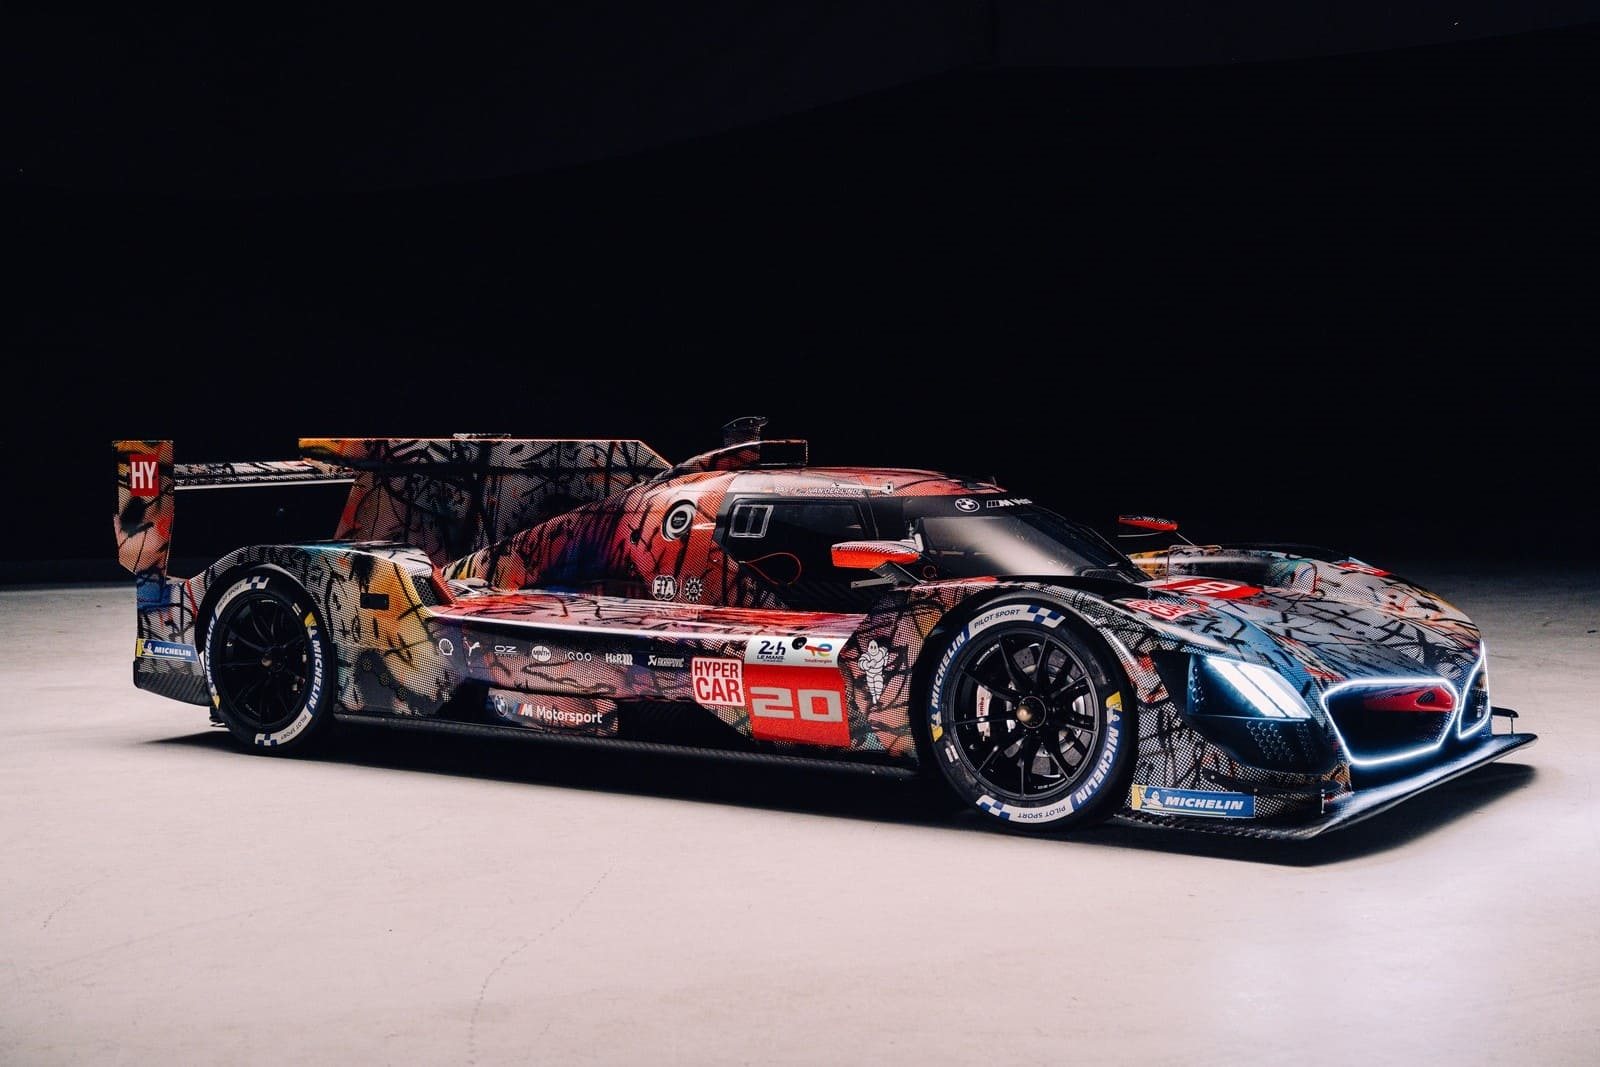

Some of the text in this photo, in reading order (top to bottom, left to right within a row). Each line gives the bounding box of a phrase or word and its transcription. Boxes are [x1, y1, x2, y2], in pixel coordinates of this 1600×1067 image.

[131, 461, 157, 489] HY
[974, 609, 1020, 629] PILOT SPORT
[154, 646, 192, 657] MICHELIN
[494, 645, 517, 653] OZ
[564, 651, 592, 662] iQOO
[309, 640, 323, 709] MICHELIN
[694, 660, 739, 678] HYPER
[931, 631, 966, 709] MICHELIN
[695, 677, 742, 703] CAR
[750, 686, 843, 723] 20
[537, 705, 603, 725] Motorsport
[280, 727, 296, 740] SPORT
[1075, 726, 1119, 805] MICHELIN
[1045, 805, 1066, 817] PILOT
[1164, 796, 1244, 810] MICHELIN
